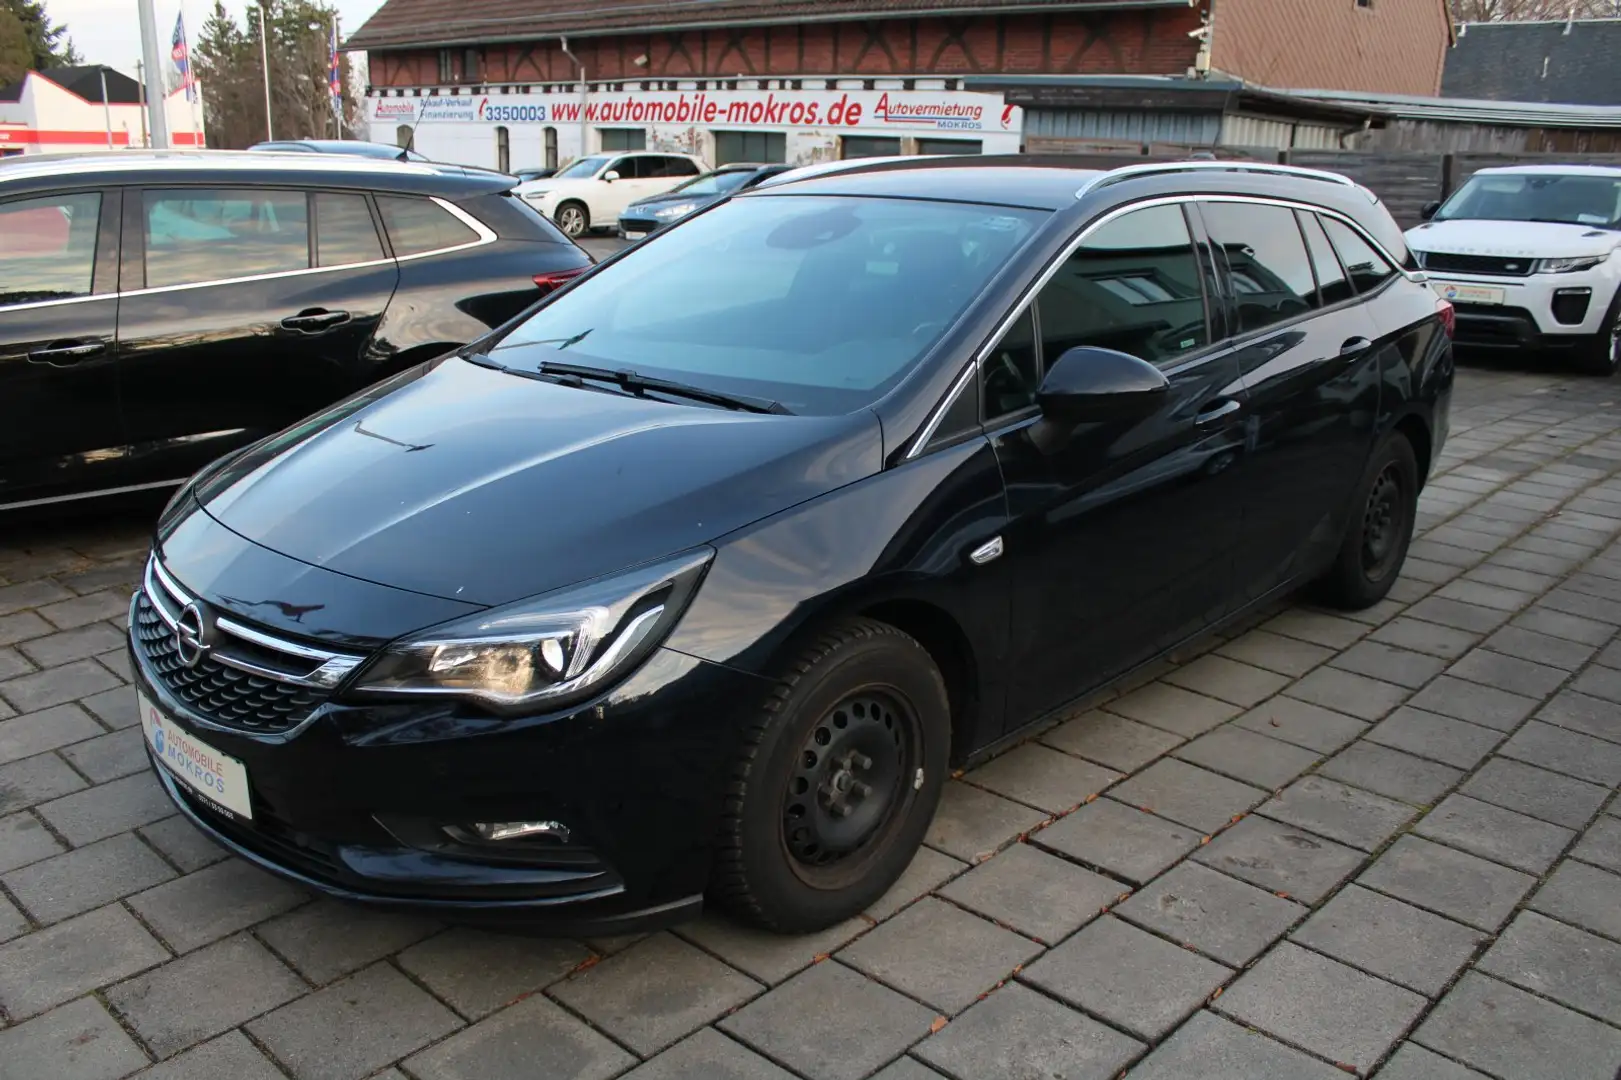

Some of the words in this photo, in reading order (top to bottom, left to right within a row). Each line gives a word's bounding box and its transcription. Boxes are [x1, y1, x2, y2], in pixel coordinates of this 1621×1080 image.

[485, 105, 546, 121] 3350003
[551, 93, 863, 124] www.automobile-mokros.de
[875, 92, 983, 120] Autovermietung
[937, 121, 983, 130] MOKROS
[168, 731, 224, 776] AUTOMOBILE
[168, 745, 225, 791] MOKROS
